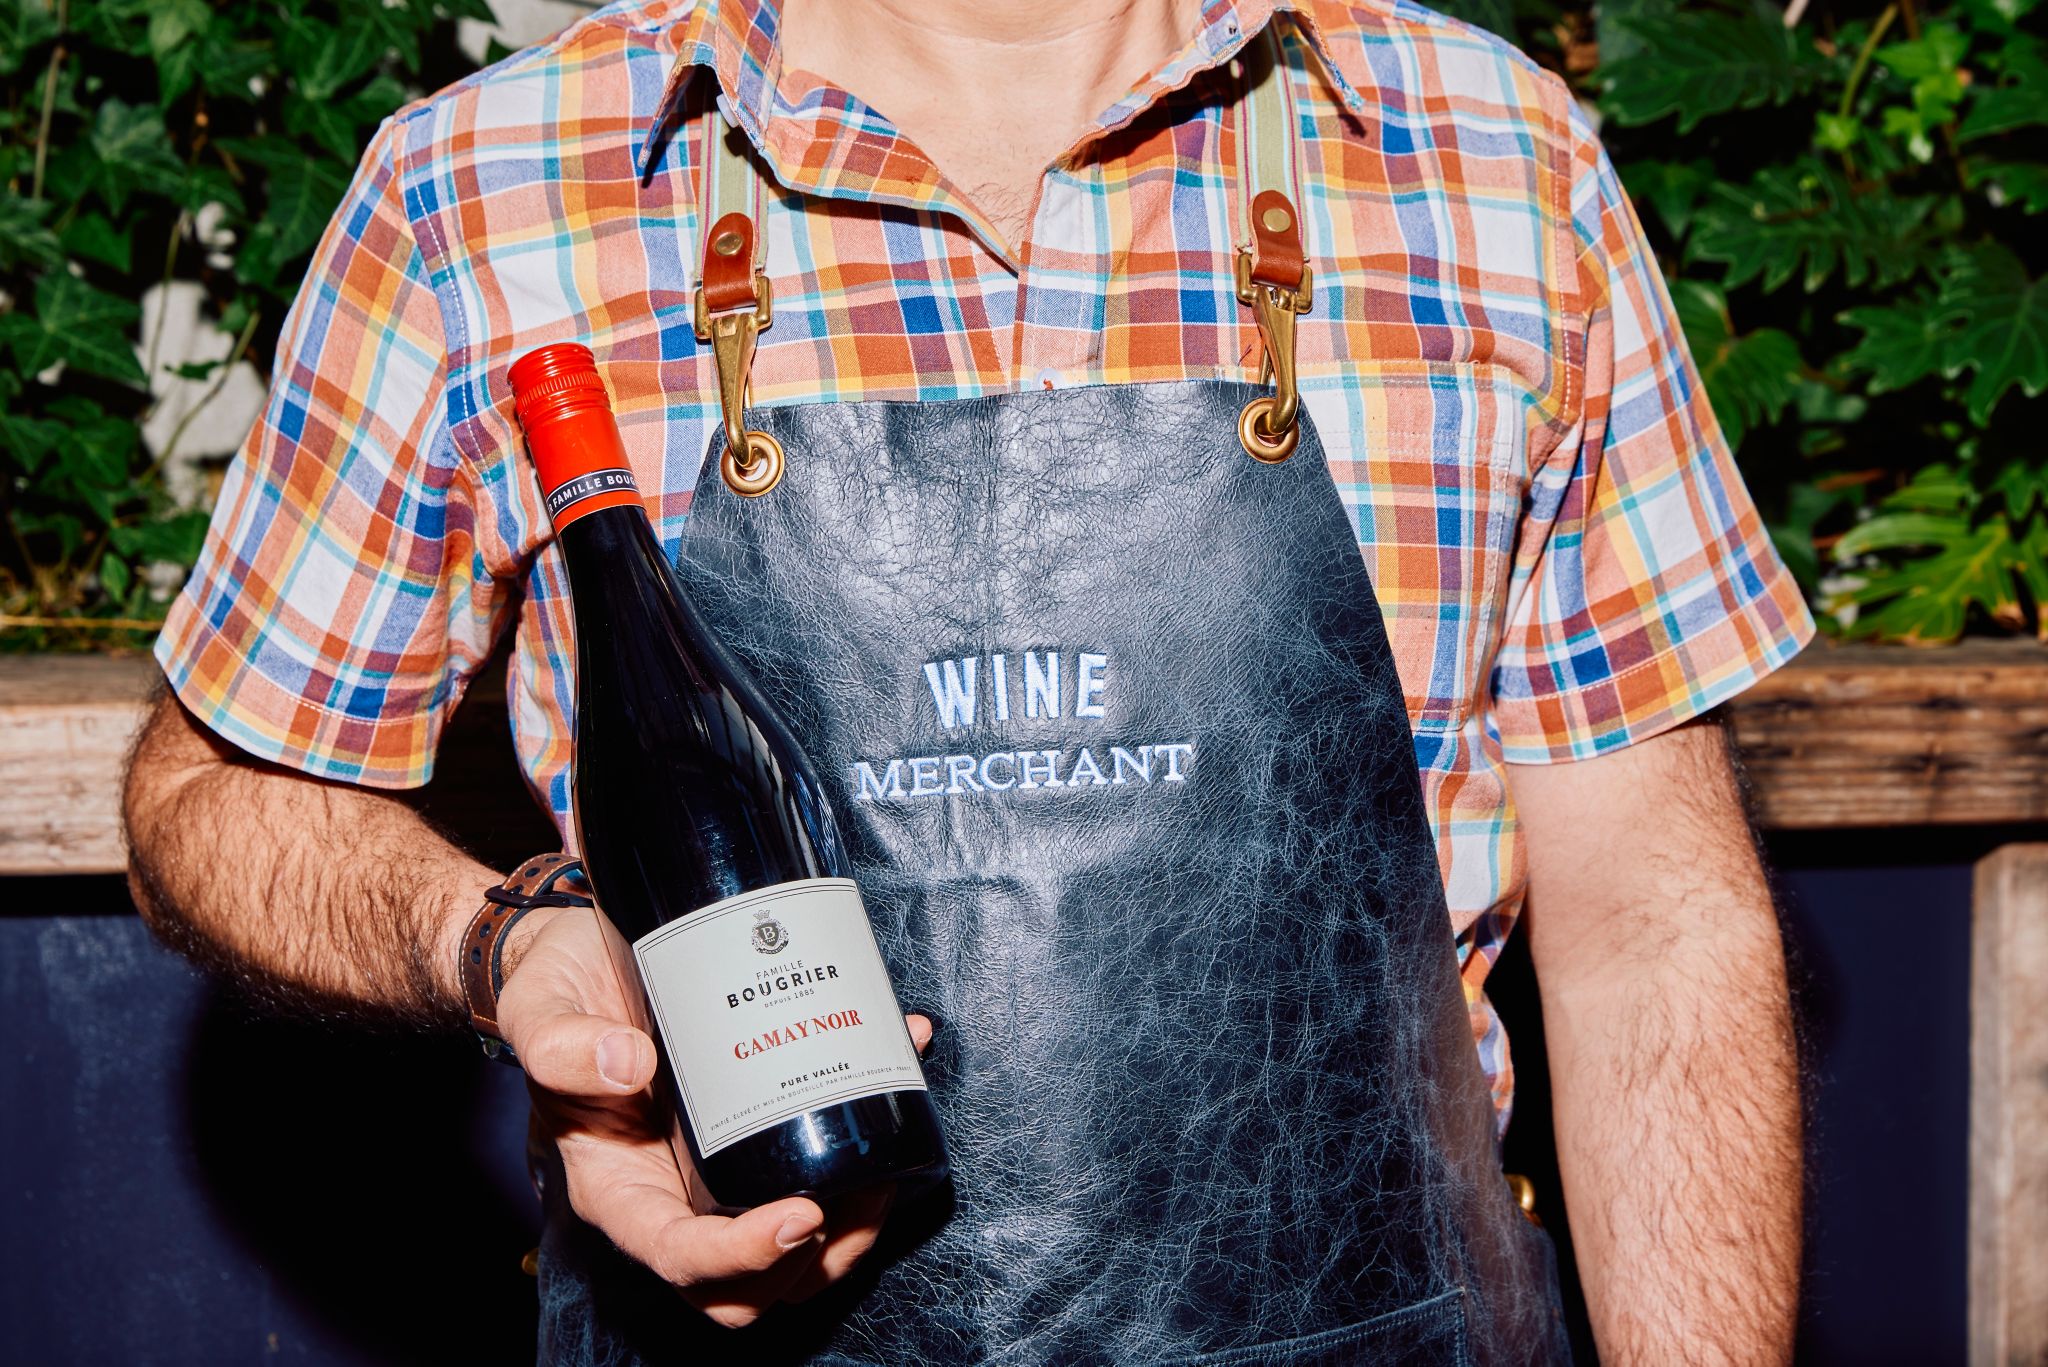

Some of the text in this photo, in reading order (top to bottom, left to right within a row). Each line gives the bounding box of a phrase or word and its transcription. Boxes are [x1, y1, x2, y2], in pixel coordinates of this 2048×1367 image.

[552, 478, 602, 508] FAMILLE
[923, 650, 1107, 729] WINE
[854, 744, 1193, 800] MERCHANT
[726, 964, 840, 1009] BOUGRIER
[756, 959, 804, 980] FAMILLE
[764, 988, 815, 1008] DEPUIS 1885
[734, 1009, 863, 1060] GAMAY NOIR
[763, 1099, 774, 1107] MIS
[777, 1094, 786, 1102] EN
[788, 1082, 824, 1098] BOUTEILLE
[826, 1078, 838, 1086] PAR
[840, 1071, 865, 1081] FAMILLE
[780, 1062, 851, 1088] PURE VALLÉE
